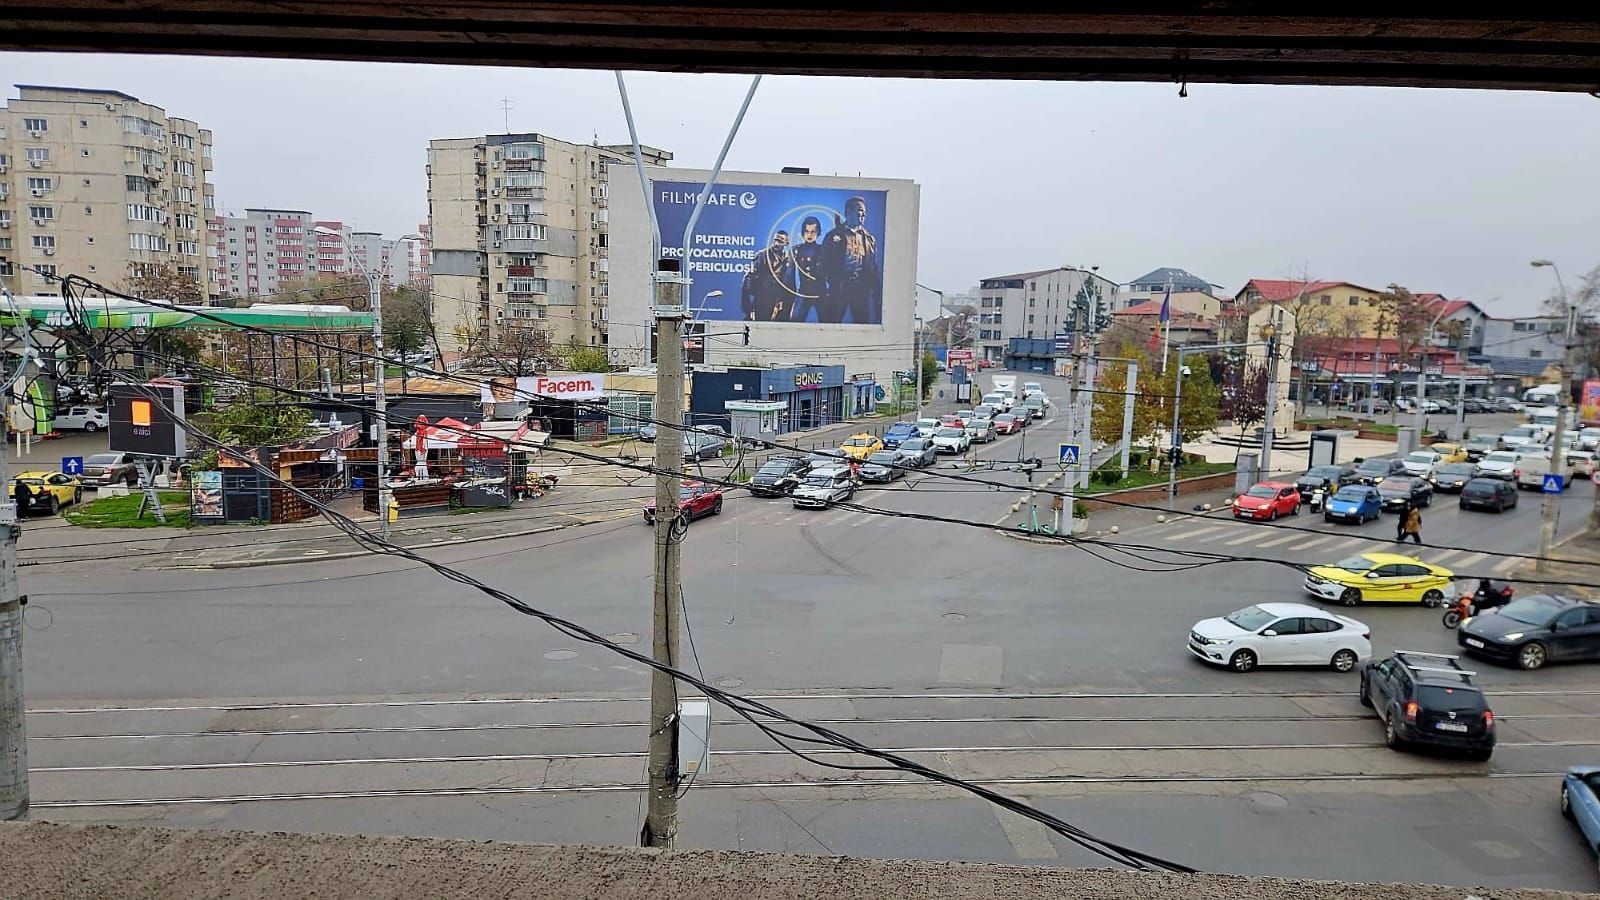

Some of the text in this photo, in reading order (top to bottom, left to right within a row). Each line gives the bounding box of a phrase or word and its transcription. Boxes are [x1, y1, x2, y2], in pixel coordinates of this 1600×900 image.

[695, 234, 755, 246] PUTERNICI
[46, 311, 77, 326] MO
[537, 378, 595, 394] Facem.
[795, 372, 824, 386] BONUS
